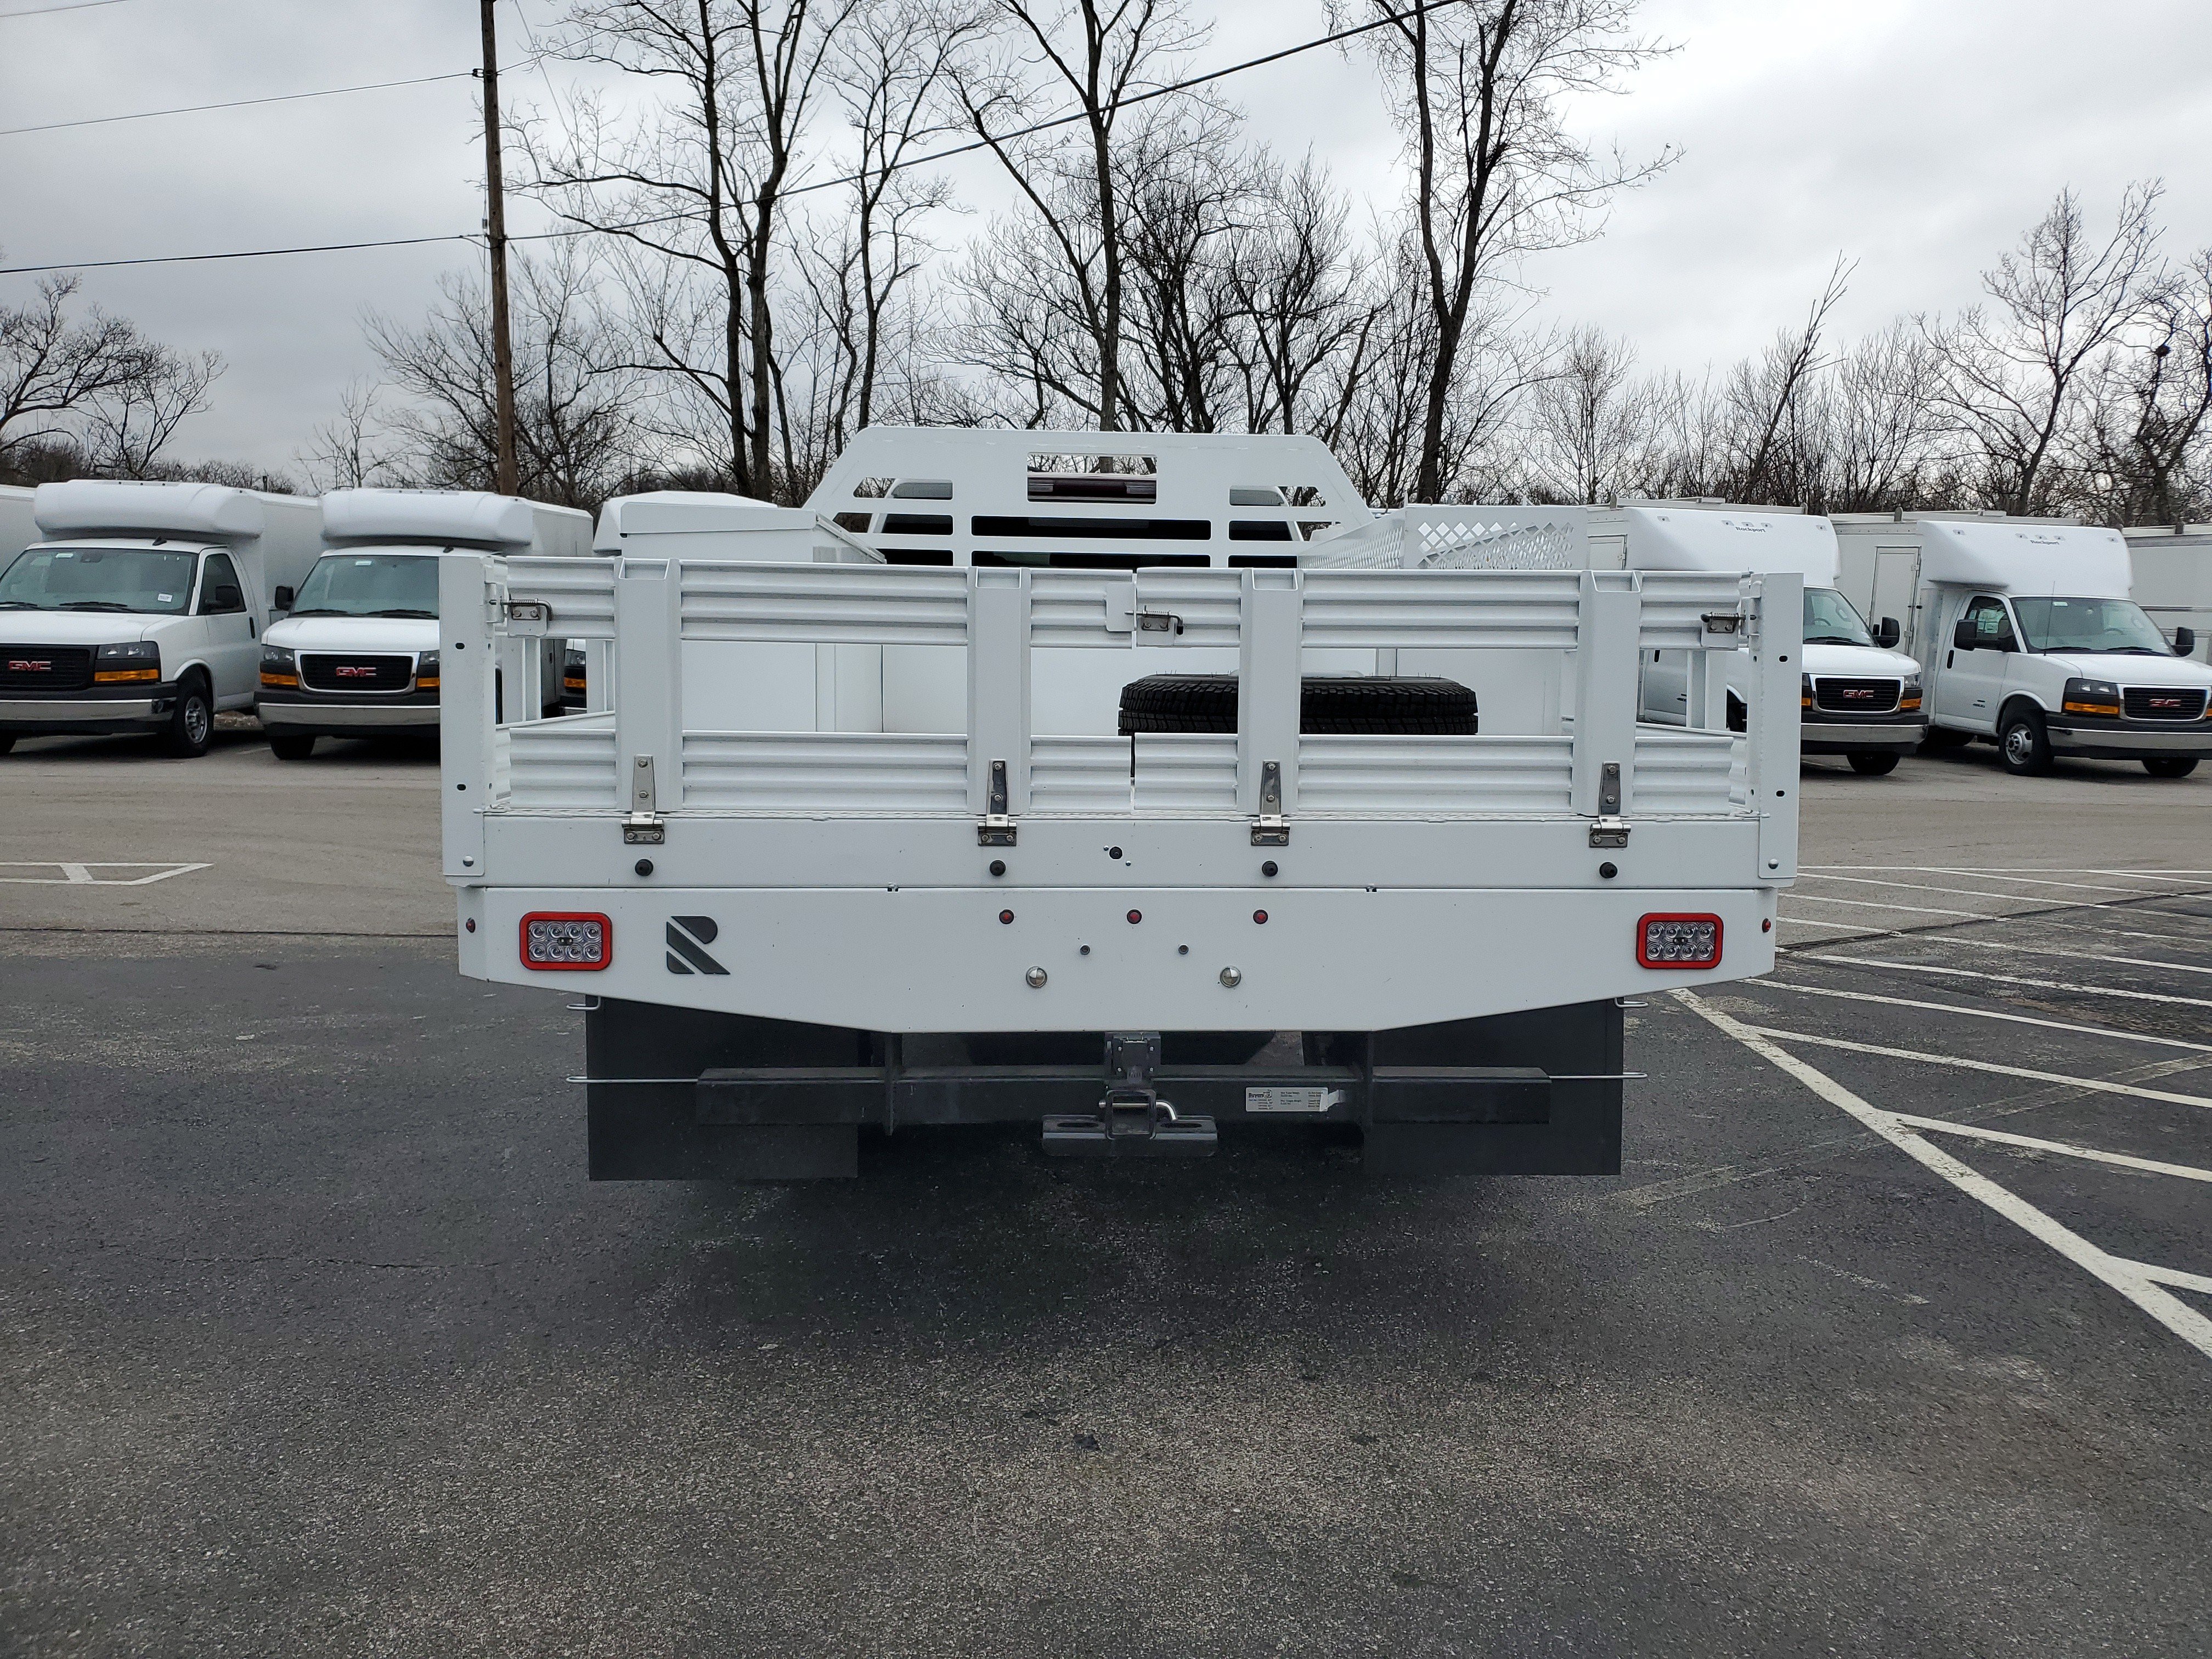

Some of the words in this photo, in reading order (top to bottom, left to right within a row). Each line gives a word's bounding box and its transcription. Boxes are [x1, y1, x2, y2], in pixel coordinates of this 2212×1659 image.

[8, 661, 52, 670] GMC
[336, 667, 377, 677] GMC
[1843, 690, 1874, 698] GMC
